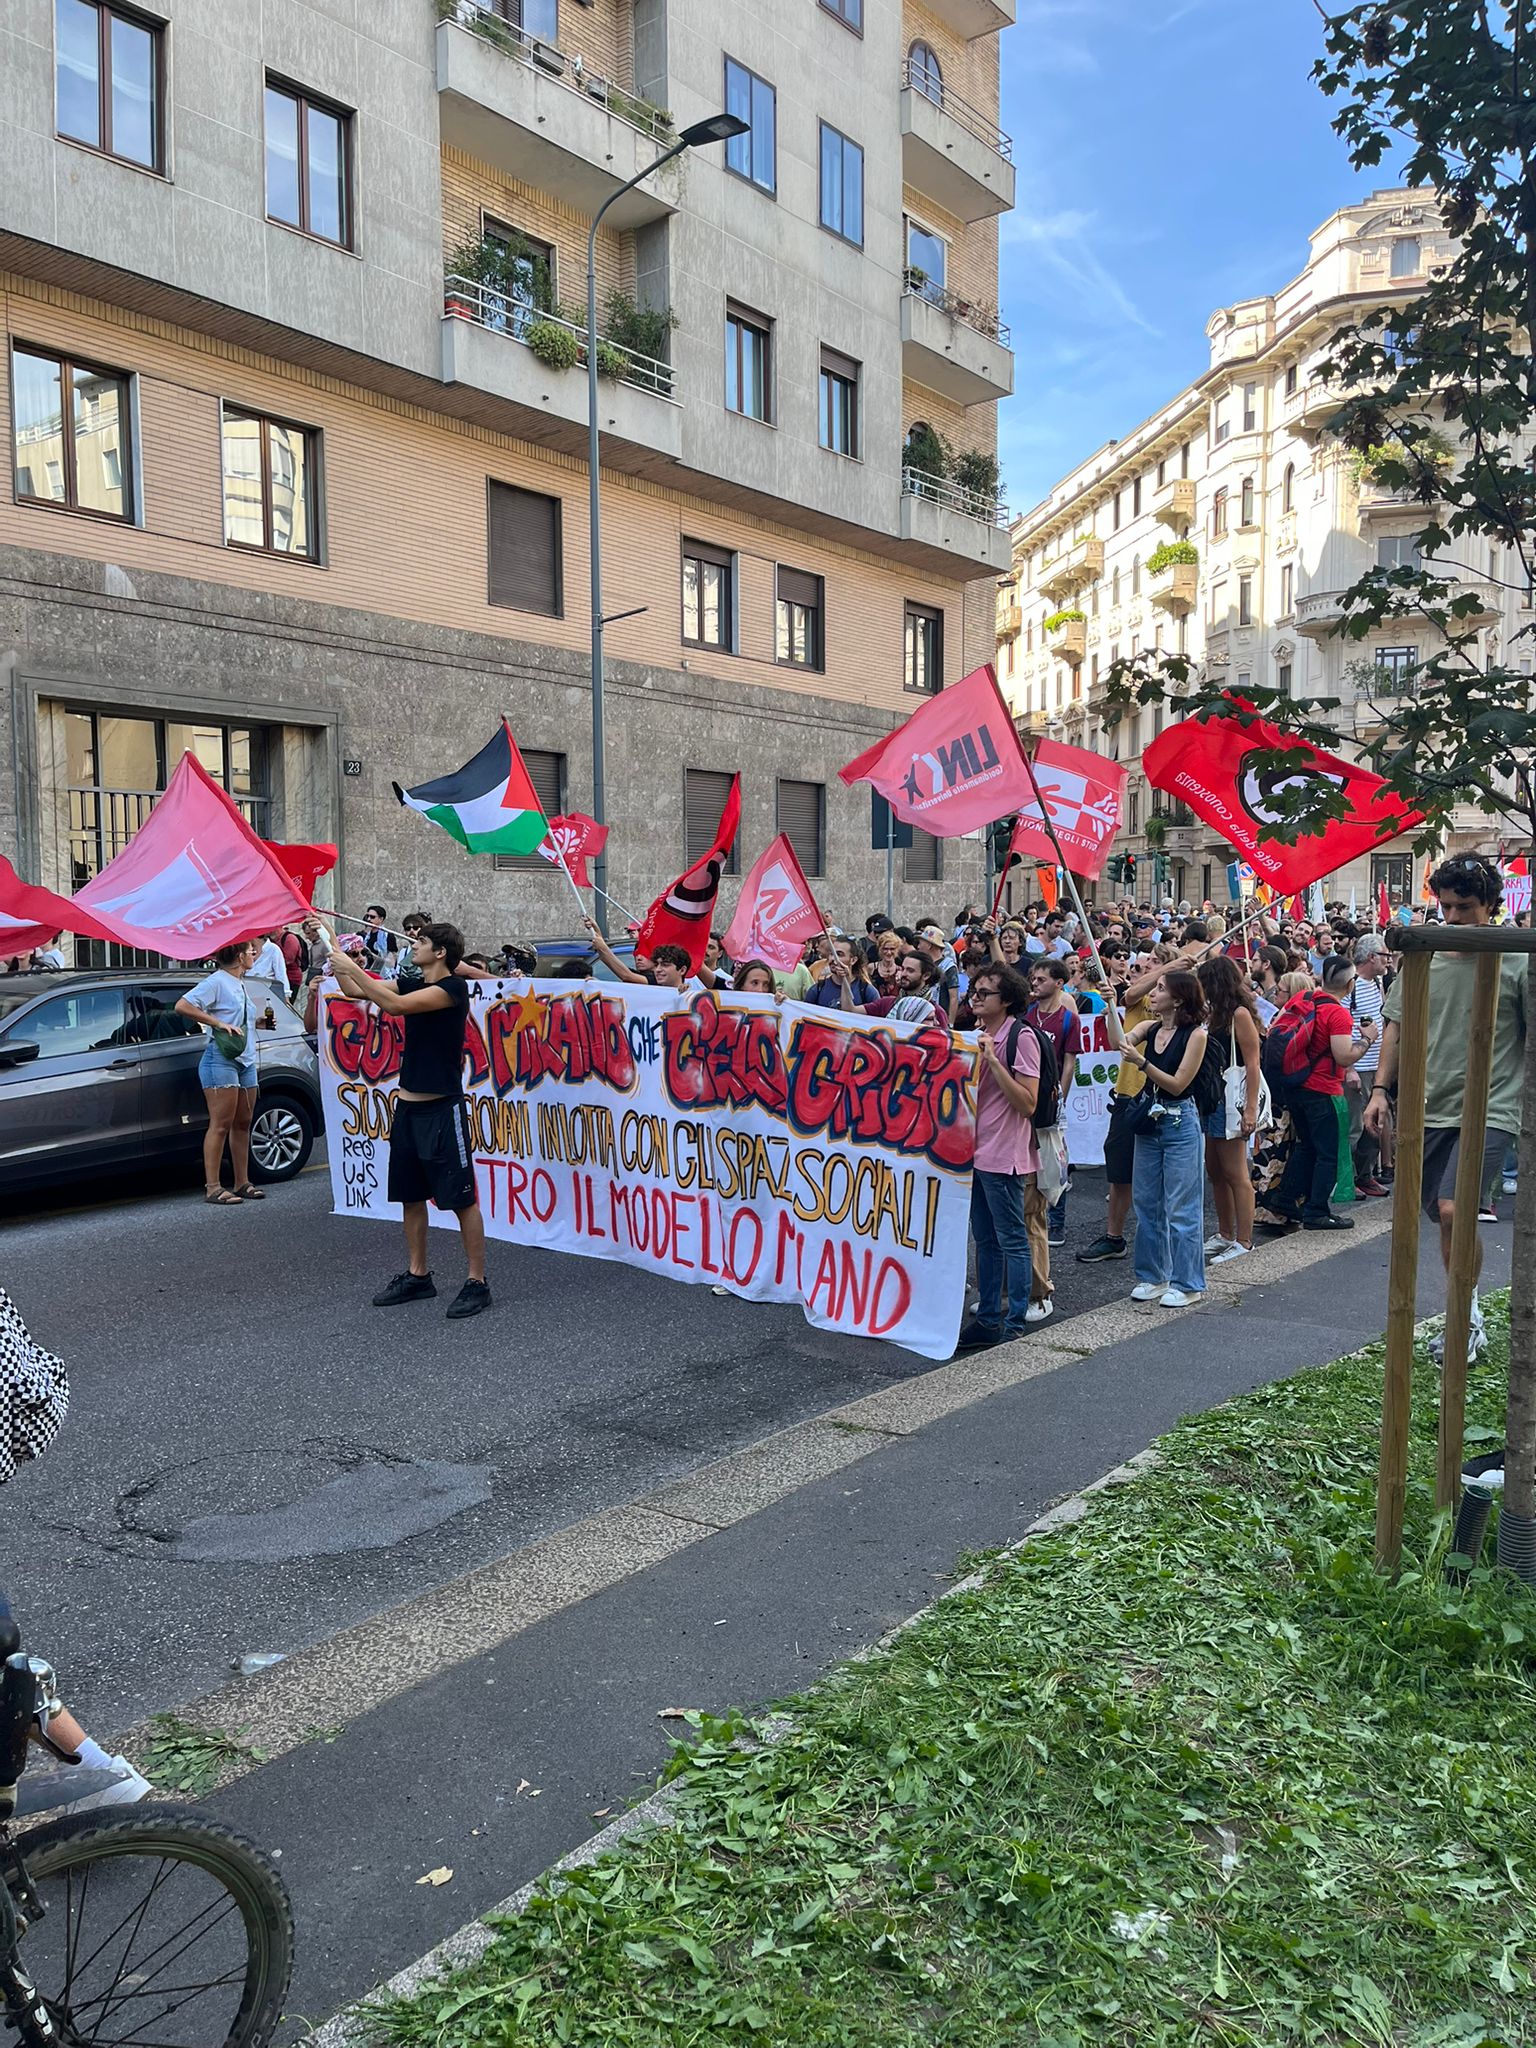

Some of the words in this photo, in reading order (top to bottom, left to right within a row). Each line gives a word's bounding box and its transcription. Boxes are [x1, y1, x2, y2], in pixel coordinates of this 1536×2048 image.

[348, 761, 360, 773] 23
[627, 1015, 664, 1065] CHE
[345, 1184, 372, 1209] LINK
[572, 1169, 607, 1238] IL
[620, 1108, 671, 1179] CON
[673, 1119, 718, 1191] GLI
[792, 1147, 943, 1258] SOCIALI
